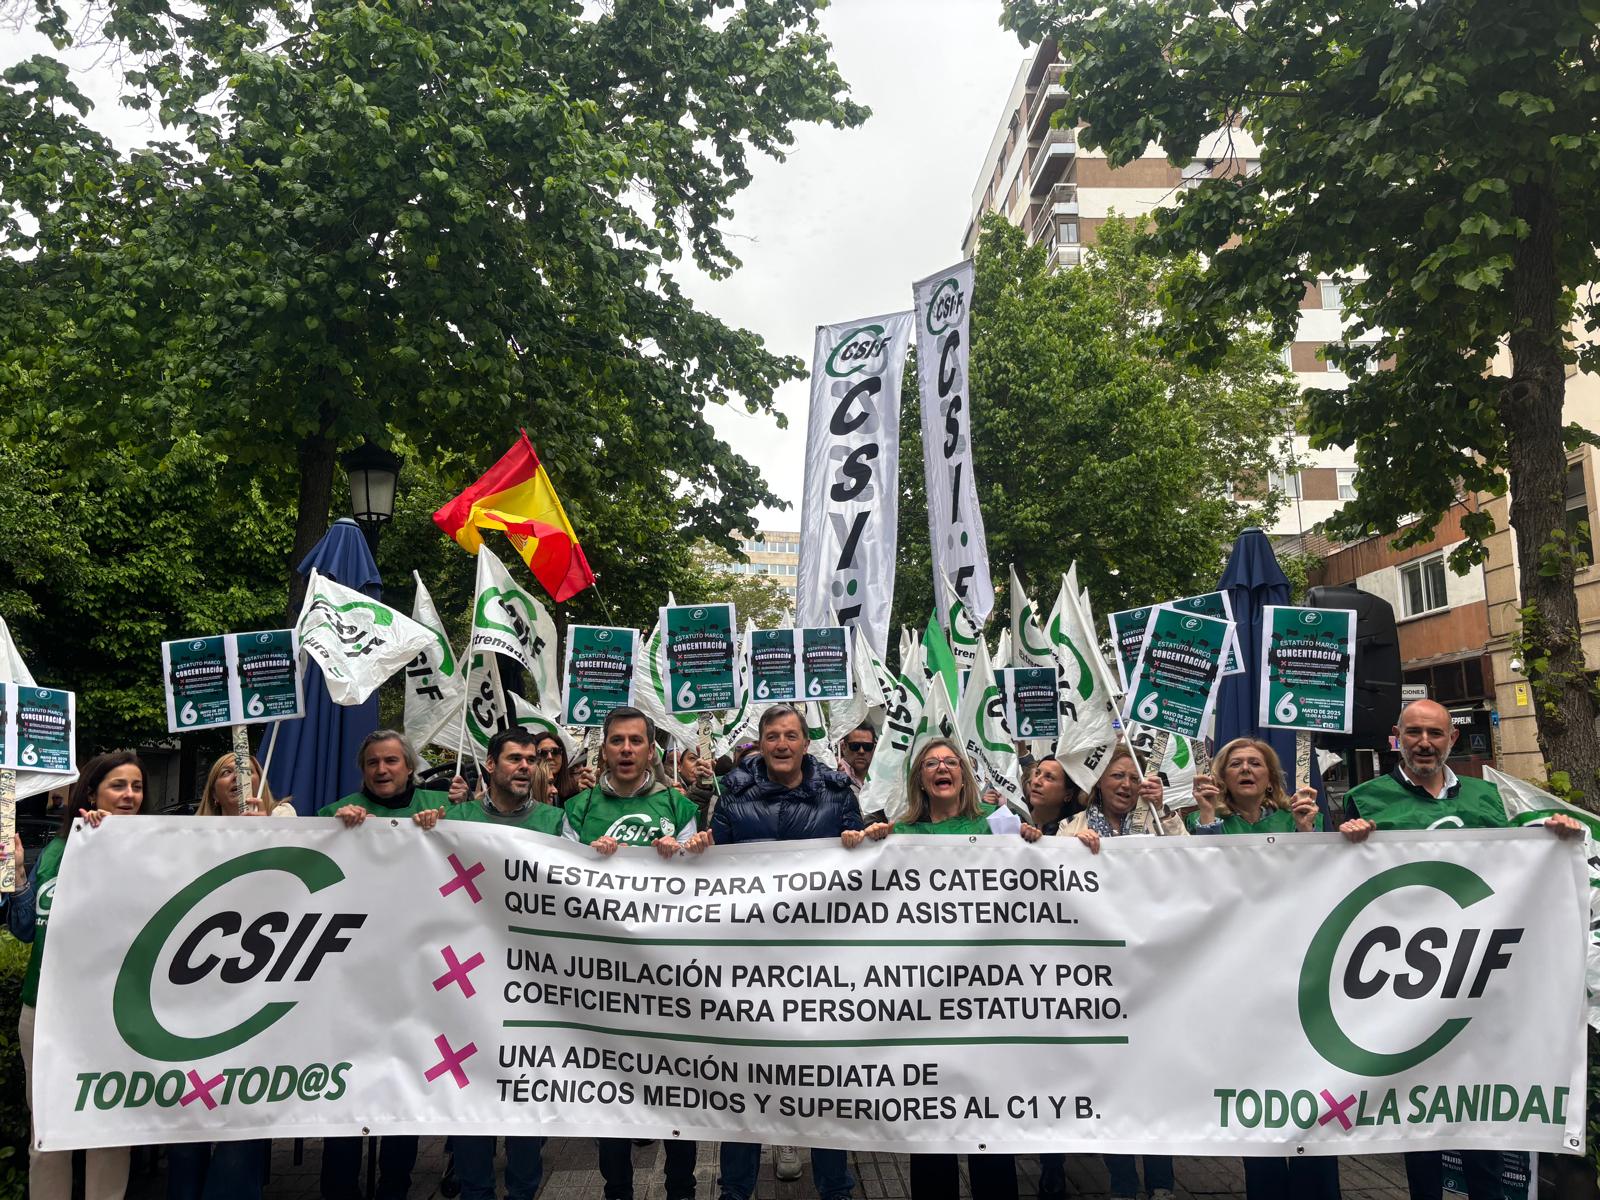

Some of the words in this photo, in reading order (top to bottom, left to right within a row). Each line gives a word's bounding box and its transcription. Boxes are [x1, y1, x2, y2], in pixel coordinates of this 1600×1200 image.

[673, 641, 727, 652] CONCENTRACIÓN
[676, 633, 703, 642] ESTATUTO
[1315, 641, 1338, 649] MARCO
[1152, 649, 1212, 670] CONCENTRACIÓN
[1158, 640, 1188, 652] ESTATUTO
[1190, 647, 1211, 659] MARCO
[1277, 649, 1342, 662] CONCENTRACIÓN
[176, 666, 224, 678] CONCENTRACIÓN
[177, 661, 202, 670] ESTATUTO
[243, 659, 290, 670] CONCENTRACIÓN
[576, 661, 626, 671] CONCENTRACIÓN
[676, 680, 696, 708] 6
[757, 680, 769, 698] 6
[808, 677, 821, 696] 6
[180, 701, 198, 725] 6
[247, 693, 264, 716] 6
[573, 696, 591, 722] 6
[1137, 692, 1159, 721] 6
[1275, 692, 1298, 723] 6
[21, 713, 65, 725] CONCENTRACIÓN
[1020, 716, 1032, 735] 6
[1451, 716, 1472, 724] EPPELIN
[22, 744, 38, 765] 6
[504, 858, 538, 882] UN
[547, 865, 686, 895] ESTATUTO
[694, 876, 766, 896] PARA
[773, 868, 863, 893] TODAS
[872, 868, 920, 892] LAS
[929, 864, 1100, 893] CATEGORÍAS
[504, 891, 556, 916] QUE
[564, 896, 721, 924] GARANTICE
[730, 902, 766, 923] LA
[772, 902, 889, 924] CALIDAD
[896, 902, 1078, 924] ASISTENCIAL.
[168, 910, 368, 985] CSIF
[506, 948, 558, 975] UNA
[564, 956, 722, 987] JUBILACIÓN
[732, 964, 856, 991] PARCIAL,
[864, 964, 1024, 988] ANTICIPADA
[1030, 964, 1047, 986] Y
[1055, 964, 1113, 986] POR
[1343, 925, 1525, 1000] CSIF
[504, 981, 692, 1019] COEFICIENTES
[700, 999, 774, 1022] PARA
[782, 999, 931, 1022] PERSONAL
[939, 998, 1128, 1020] ESTATUTARIO.
[499, 1046, 556, 1068] UNA
[562, 1046, 738, 1083] ADECUACIÓN
[749, 1063, 896, 1088] INMEDIATA
[903, 1063, 938, 1087] DE
[496, 1074, 635, 1104] TÉCNICOS
[643, 1084, 746, 1114] MEDIOS
[754, 1094, 771, 1114] Y
[778, 1096, 956, 1122] SUPERIORES
[964, 1096, 999, 1119] AL
[1007, 1096, 1038, 1119] C1
[1048, 1096, 1066, 1119] Y
[1075, 1096, 1101, 1120] B.
